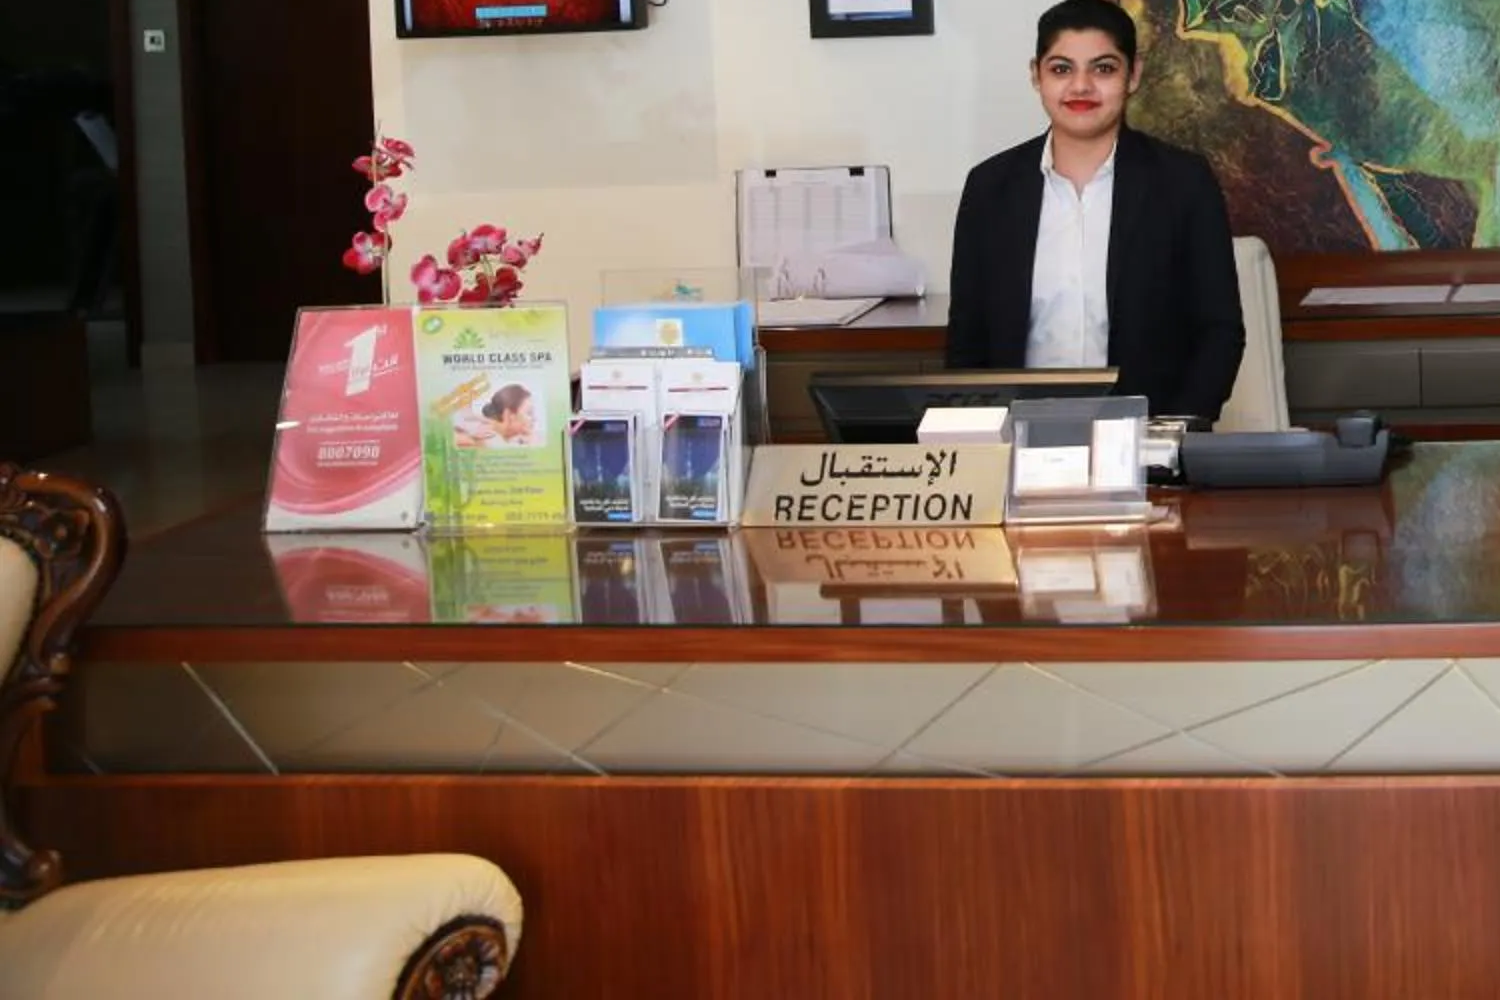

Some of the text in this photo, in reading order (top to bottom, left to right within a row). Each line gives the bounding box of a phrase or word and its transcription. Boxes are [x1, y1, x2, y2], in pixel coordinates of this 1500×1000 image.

[442, 352, 553, 365] WORLD CLASS SPA
[800, 451, 957, 487] الإستقبال
[774, 493, 973, 521] RECEPTION
